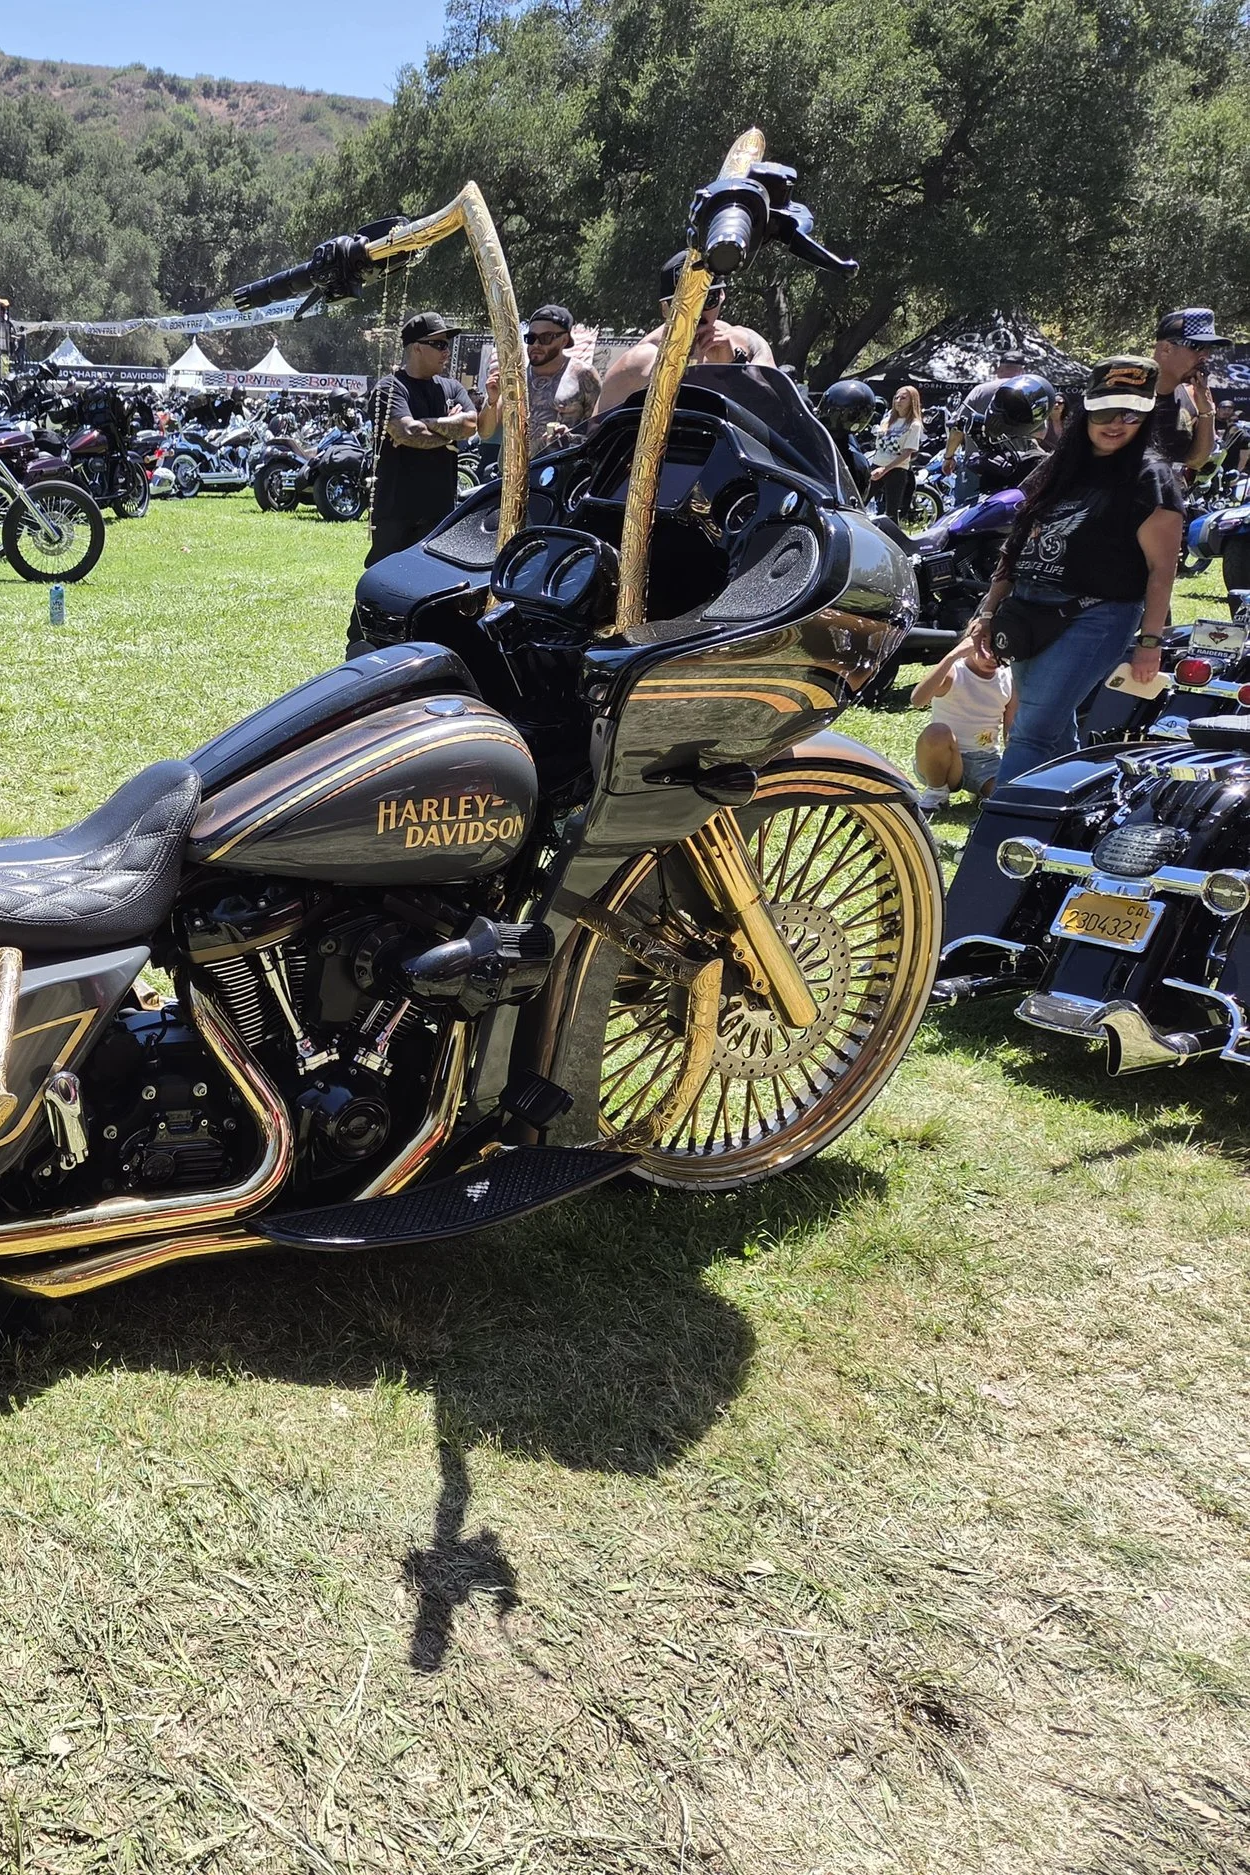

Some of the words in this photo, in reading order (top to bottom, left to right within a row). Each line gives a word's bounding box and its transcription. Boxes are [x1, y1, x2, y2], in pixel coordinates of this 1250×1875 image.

[120, 371, 165, 380] DAVIDSON
[226, 372, 262, 386] BORN
[309, 375, 344, 389] BORN
[918, 382, 942, 390] BORN
[945, 383, 960, 391] ON
[1196, 648, 1228, 658] RAIDERS
[405, 814, 527, 848] DAVIDSON
[1126, 905, 1152, 919] CAL
